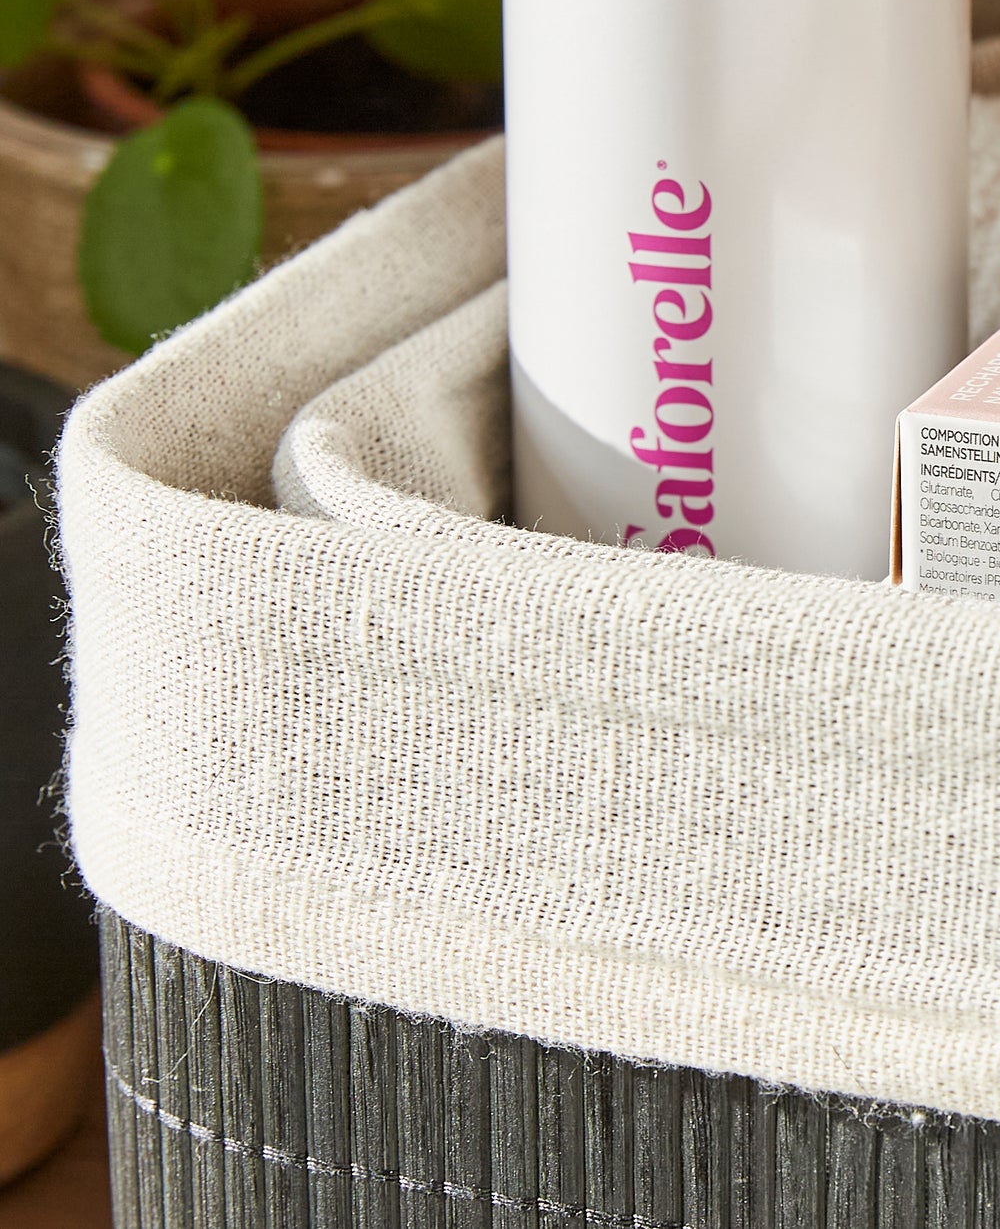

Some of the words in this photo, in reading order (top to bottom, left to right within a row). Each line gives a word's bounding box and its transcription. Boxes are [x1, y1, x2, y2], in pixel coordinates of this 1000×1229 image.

[921, 427, 999, 447] COMPOSITION
[920, 480, 974, 500] Glutamate,
[920, 514, 982, 535] Bicarbonate,
[920, 531, 958, 547] Sodium
[926, 549, 980, 566] Biologique
[919, 566, 982, 585] Laboratoires
